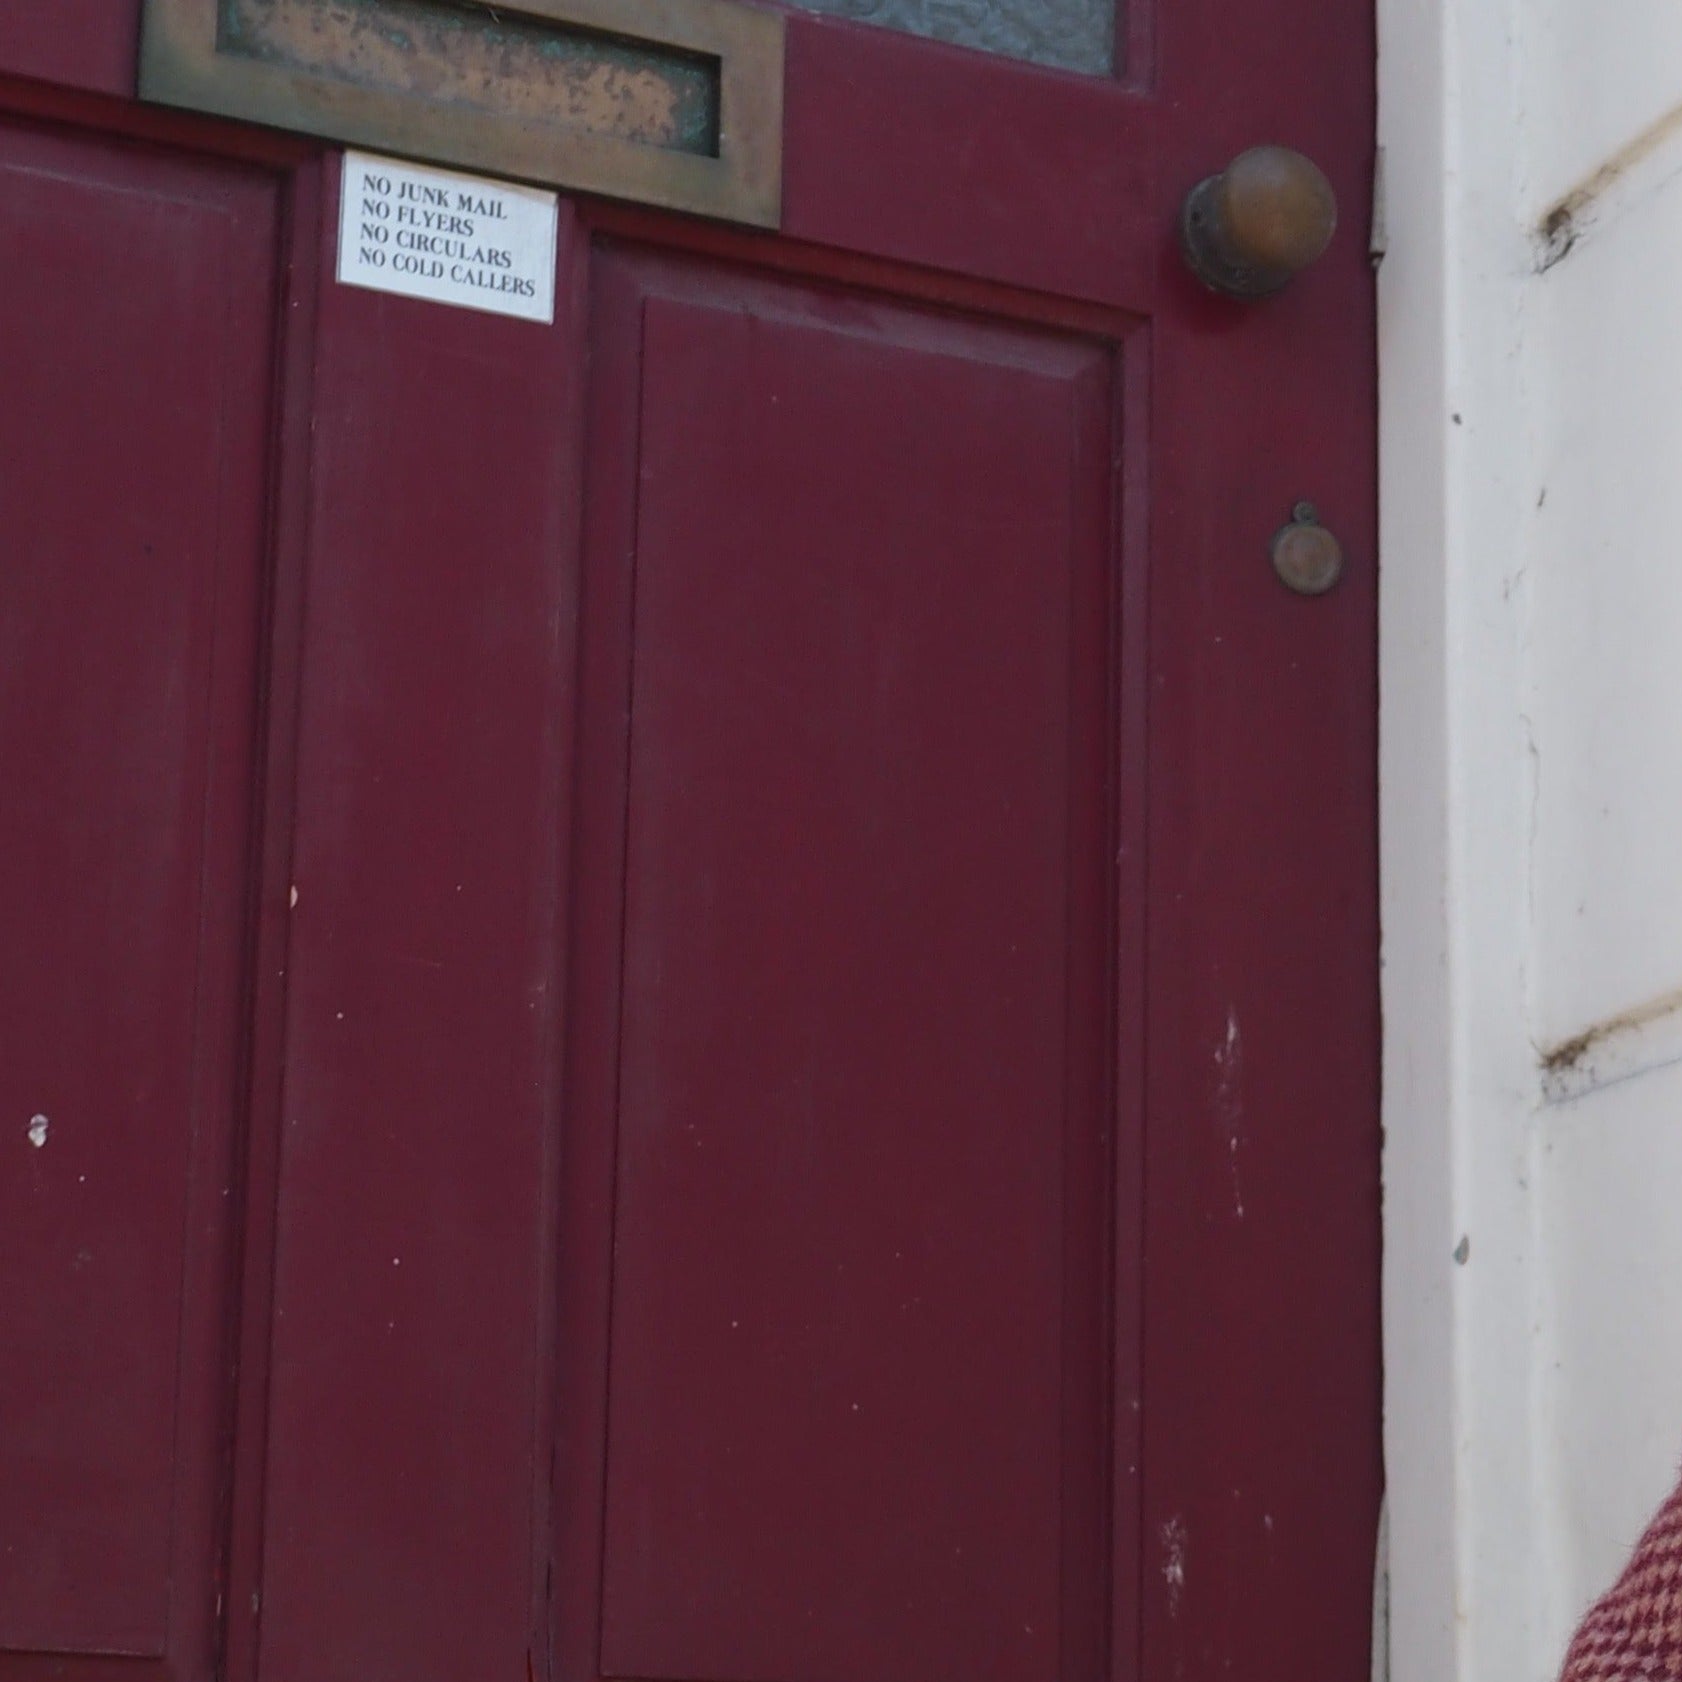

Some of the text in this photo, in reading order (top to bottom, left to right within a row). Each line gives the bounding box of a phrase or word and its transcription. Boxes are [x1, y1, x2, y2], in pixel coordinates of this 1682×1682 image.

[361, 198, 474, 237] NO FLYERS
[363, 174, 507, 220] NO JUNK MAIL
[360, 222, 512, 269] NO CIRCULARS
[359, 246, 536, 298] NO COLD CALLERS
